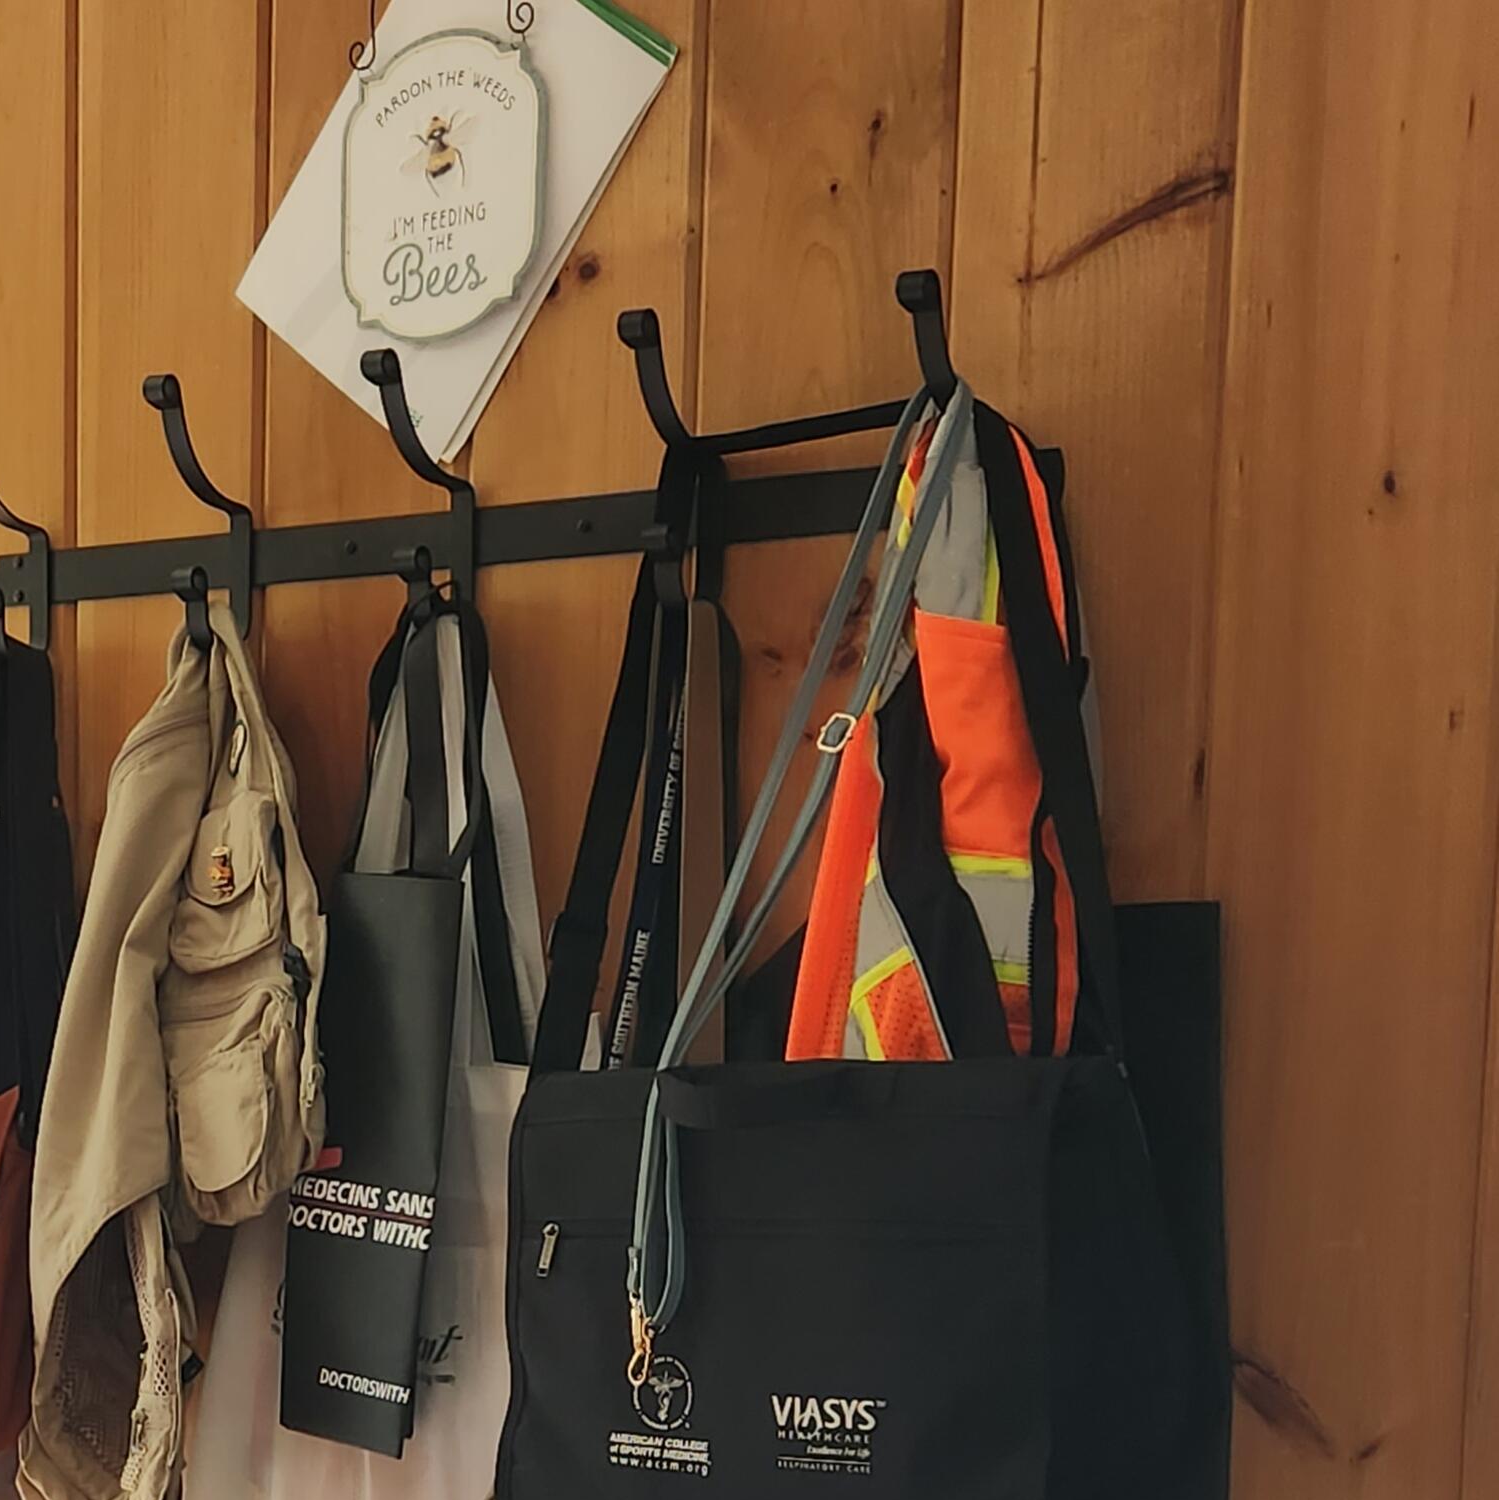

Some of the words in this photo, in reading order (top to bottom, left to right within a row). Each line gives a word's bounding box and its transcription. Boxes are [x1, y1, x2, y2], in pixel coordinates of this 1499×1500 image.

[375, 77, 432, 127] PARDON
[437, 69, 465, 88] THE
[472, 73, 516, 111] WEEDS
[392, 215, 414, 240] I'M
[422, 201, 486, 232] FEEDING
[427, 232, 453, 255] THE
[383, 243, 487, 306] Bees
[652, 771, 679, 864] UNIVERSITY
[669, 744, 682, 770] OF
[626, 929, 651, 979] MAINE
[612, 979, 642, 1049] SOUTHERN
[385, 1189, 435, 1219] SANS
[319, 1367, 410, 1405] DOCTORSWITH
[609, 1444, 619, 1453] of
[619, 1445, 661, 1458] SPORTS
[610, 1432, 663, 1446] AMERICAN
[665, 1438, 708, 1451] COLLEGE
[777, 1430, 870, 1444] HEALTHCARE
[610, 1456, 708, 1477] www.acsm.org
[777, 1460, 840, 1472] RESPIRATORY
[846, 1464, 871, 1474] CARE
